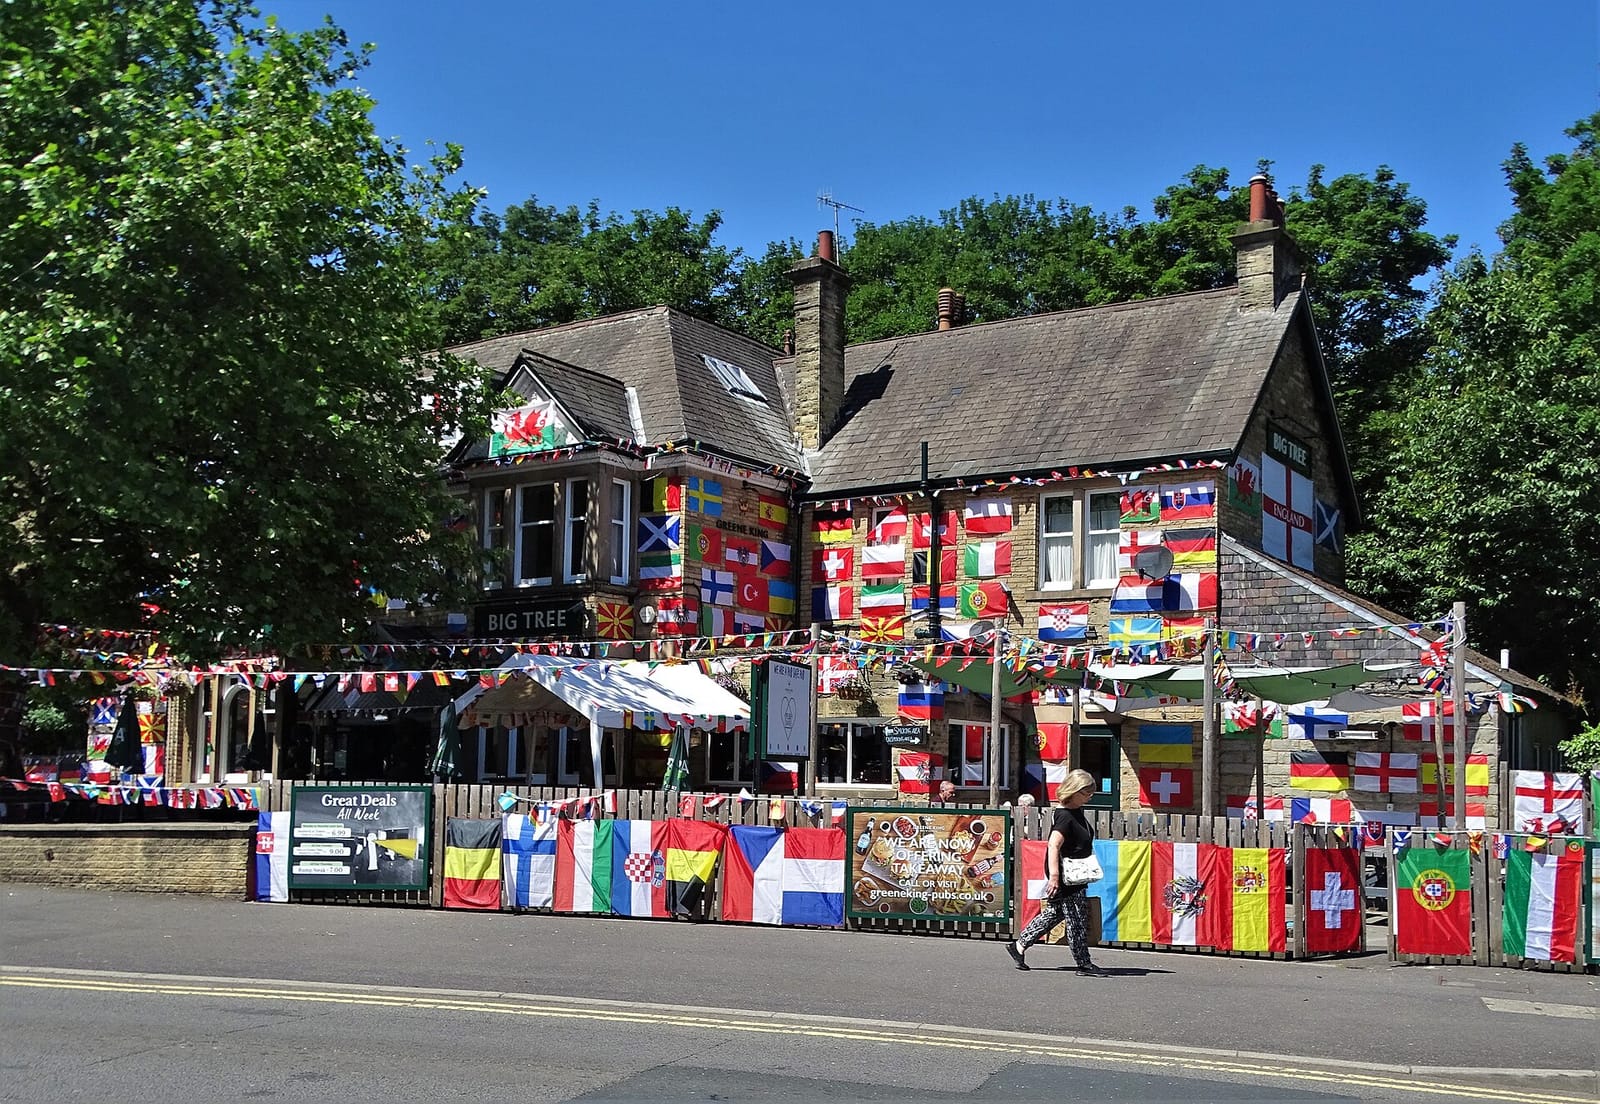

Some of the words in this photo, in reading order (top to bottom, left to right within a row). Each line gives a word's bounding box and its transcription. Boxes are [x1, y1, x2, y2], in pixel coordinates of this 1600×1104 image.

[1273, 432, 1287, 455] BIG
[1288, 441, 1307, 466] TREE
[1273, 503, 1305, 528] ENGLAND
[715, 519, 748, 535] GREENE
[749, 526, 769, 539] KING
[488, 612, 518, 631] BIG
[522, 609, 567, 630] TREE
[321, 794, 358, 807] Great
[360, 794, 397, 807] Deals
[336, 807, 350, 820] All
[354, 807, 381, 820] Week
[884, 838, 905, 848] WE
[909, 838, 935, 849] ARE
[938, 838, 975, 849] NOW
[896, 850, 962, 863] OFFERING
[892, 863, 965, 875] TAKEAWAY
[898, 879, 920, 888] CALL
[922, 880, 935, 888] OR
[937, 880, 958, 888] VISIT
[869, 889, 987, 901] greeneking-pubs.co.uk
